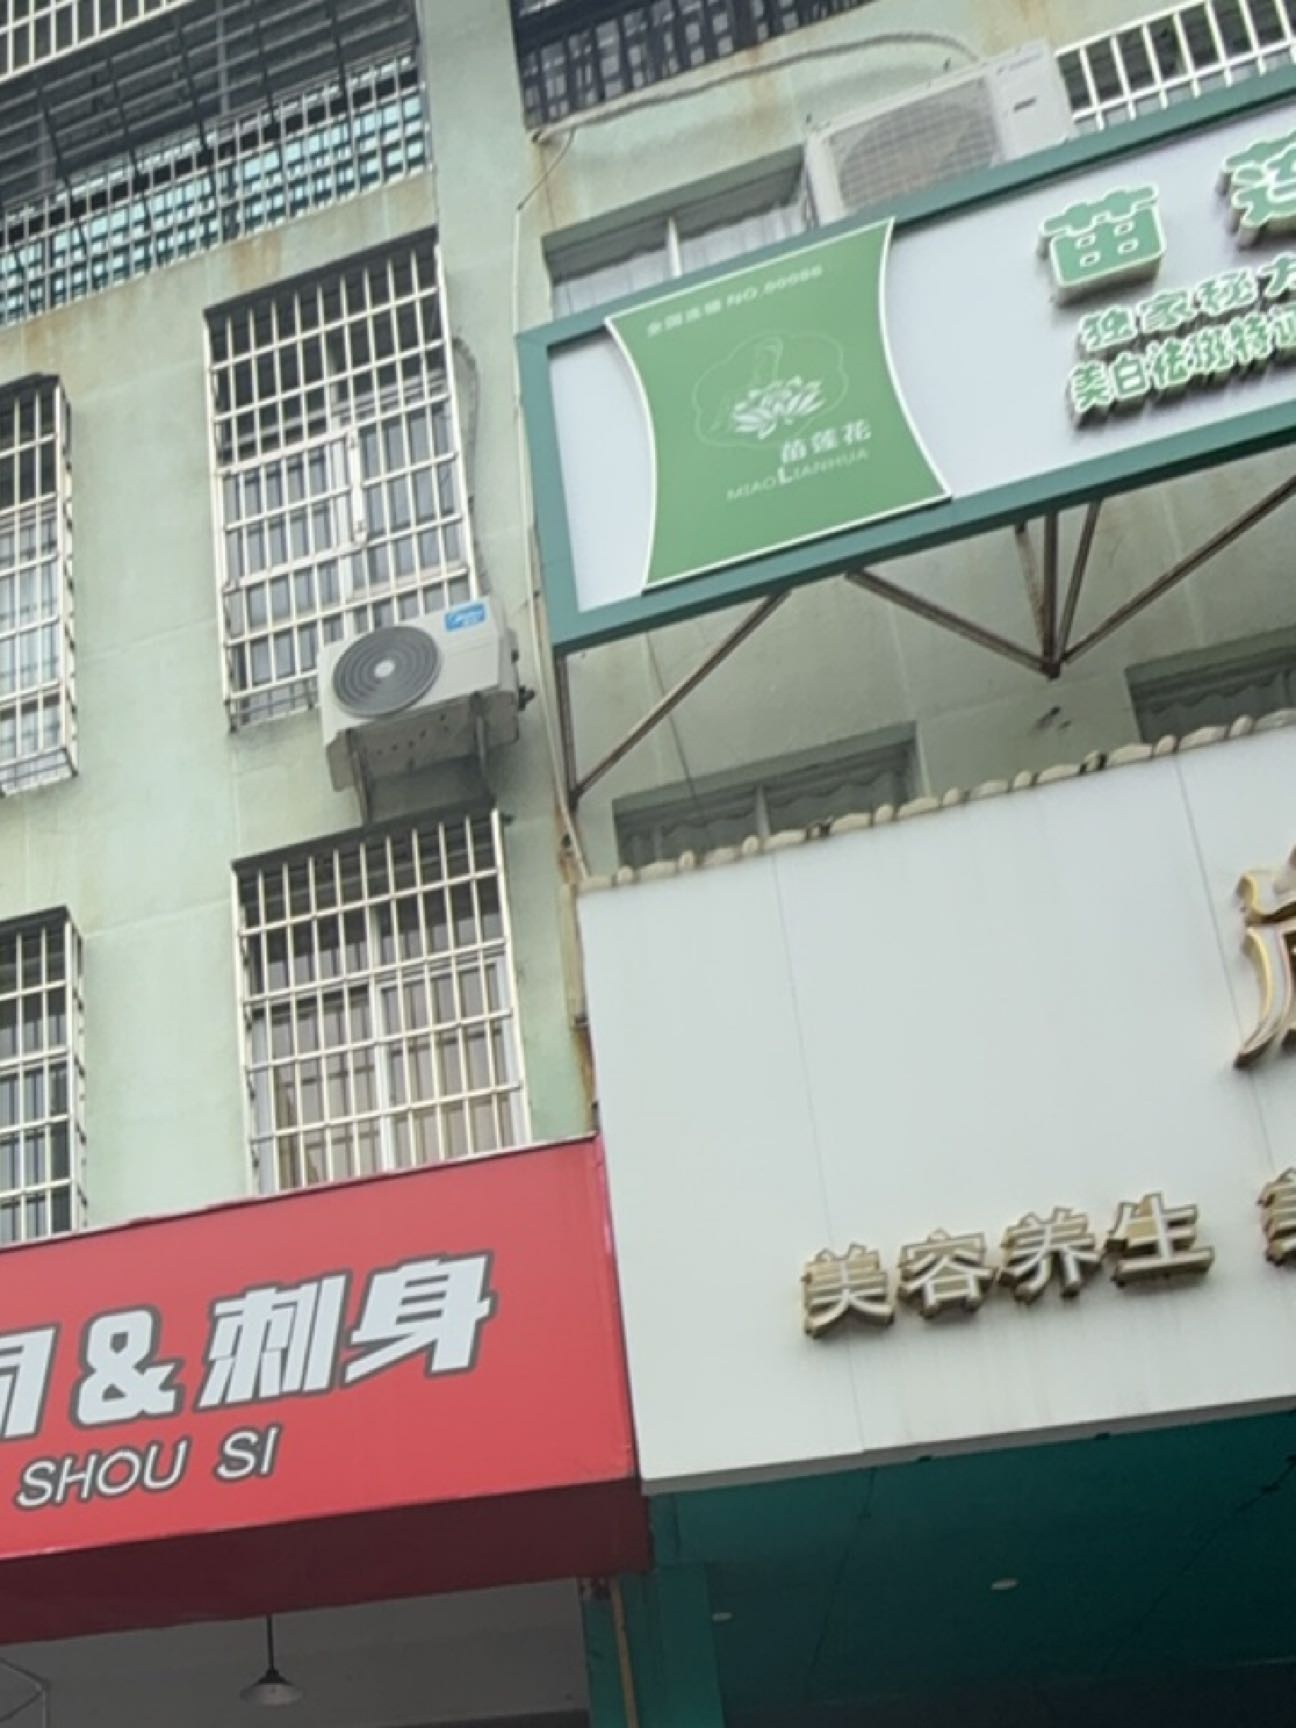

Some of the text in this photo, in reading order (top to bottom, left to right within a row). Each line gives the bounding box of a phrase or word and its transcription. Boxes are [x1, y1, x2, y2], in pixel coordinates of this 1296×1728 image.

[800, 1191, 1214, 1340] 美容养生
[16, 1437, 189, 1509] SHOU
[215, 1425, 282, 1480] SI
